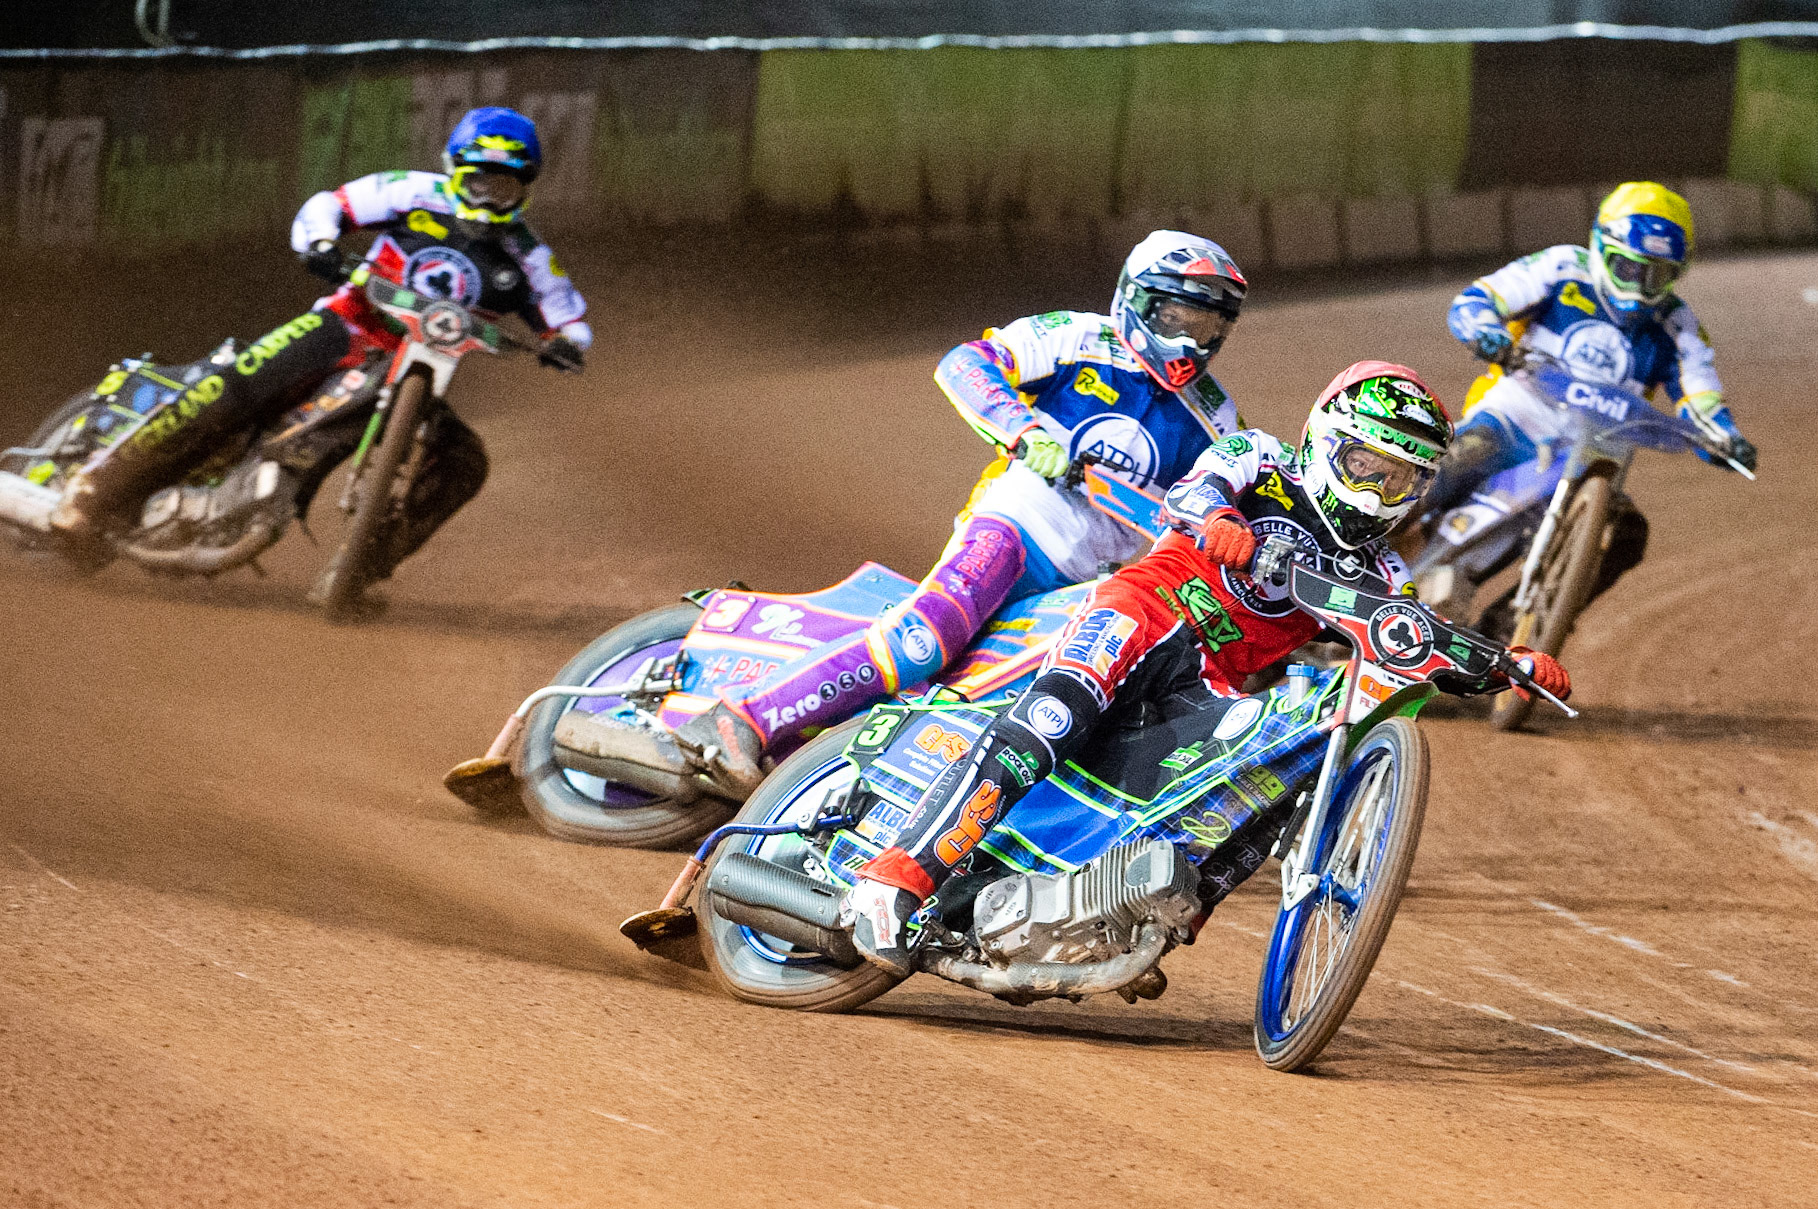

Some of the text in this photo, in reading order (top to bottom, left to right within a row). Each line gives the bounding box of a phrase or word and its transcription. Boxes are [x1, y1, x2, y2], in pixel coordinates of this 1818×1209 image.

[1565, 381, 1629, 422] Civil
[1087, 439, 1149, 491] ATPI
[1255, 522, 1292, 535] BELLE
[1063, 608, 1116, 663] ALBON
[1375, 606, 1399, 622] BELLE
[1401, 607, 1418, 621] VUE
[1417, 620, 1431, 641] ACES
[910, 634, 928, 656] ATPI
[1105, 634, 1123, 659] plc
[857, 713, 901, 747] 3
[1037, 704, 1065, 729] ATPI
[914, 722, 972, 764] CFS
[932, 758, 969, 807] OUTLET
[1002, 747, 1036, 786] ROCK OIL
[873, 829, 891, 845] plc
[934, 778, 1002, 867] CFS
